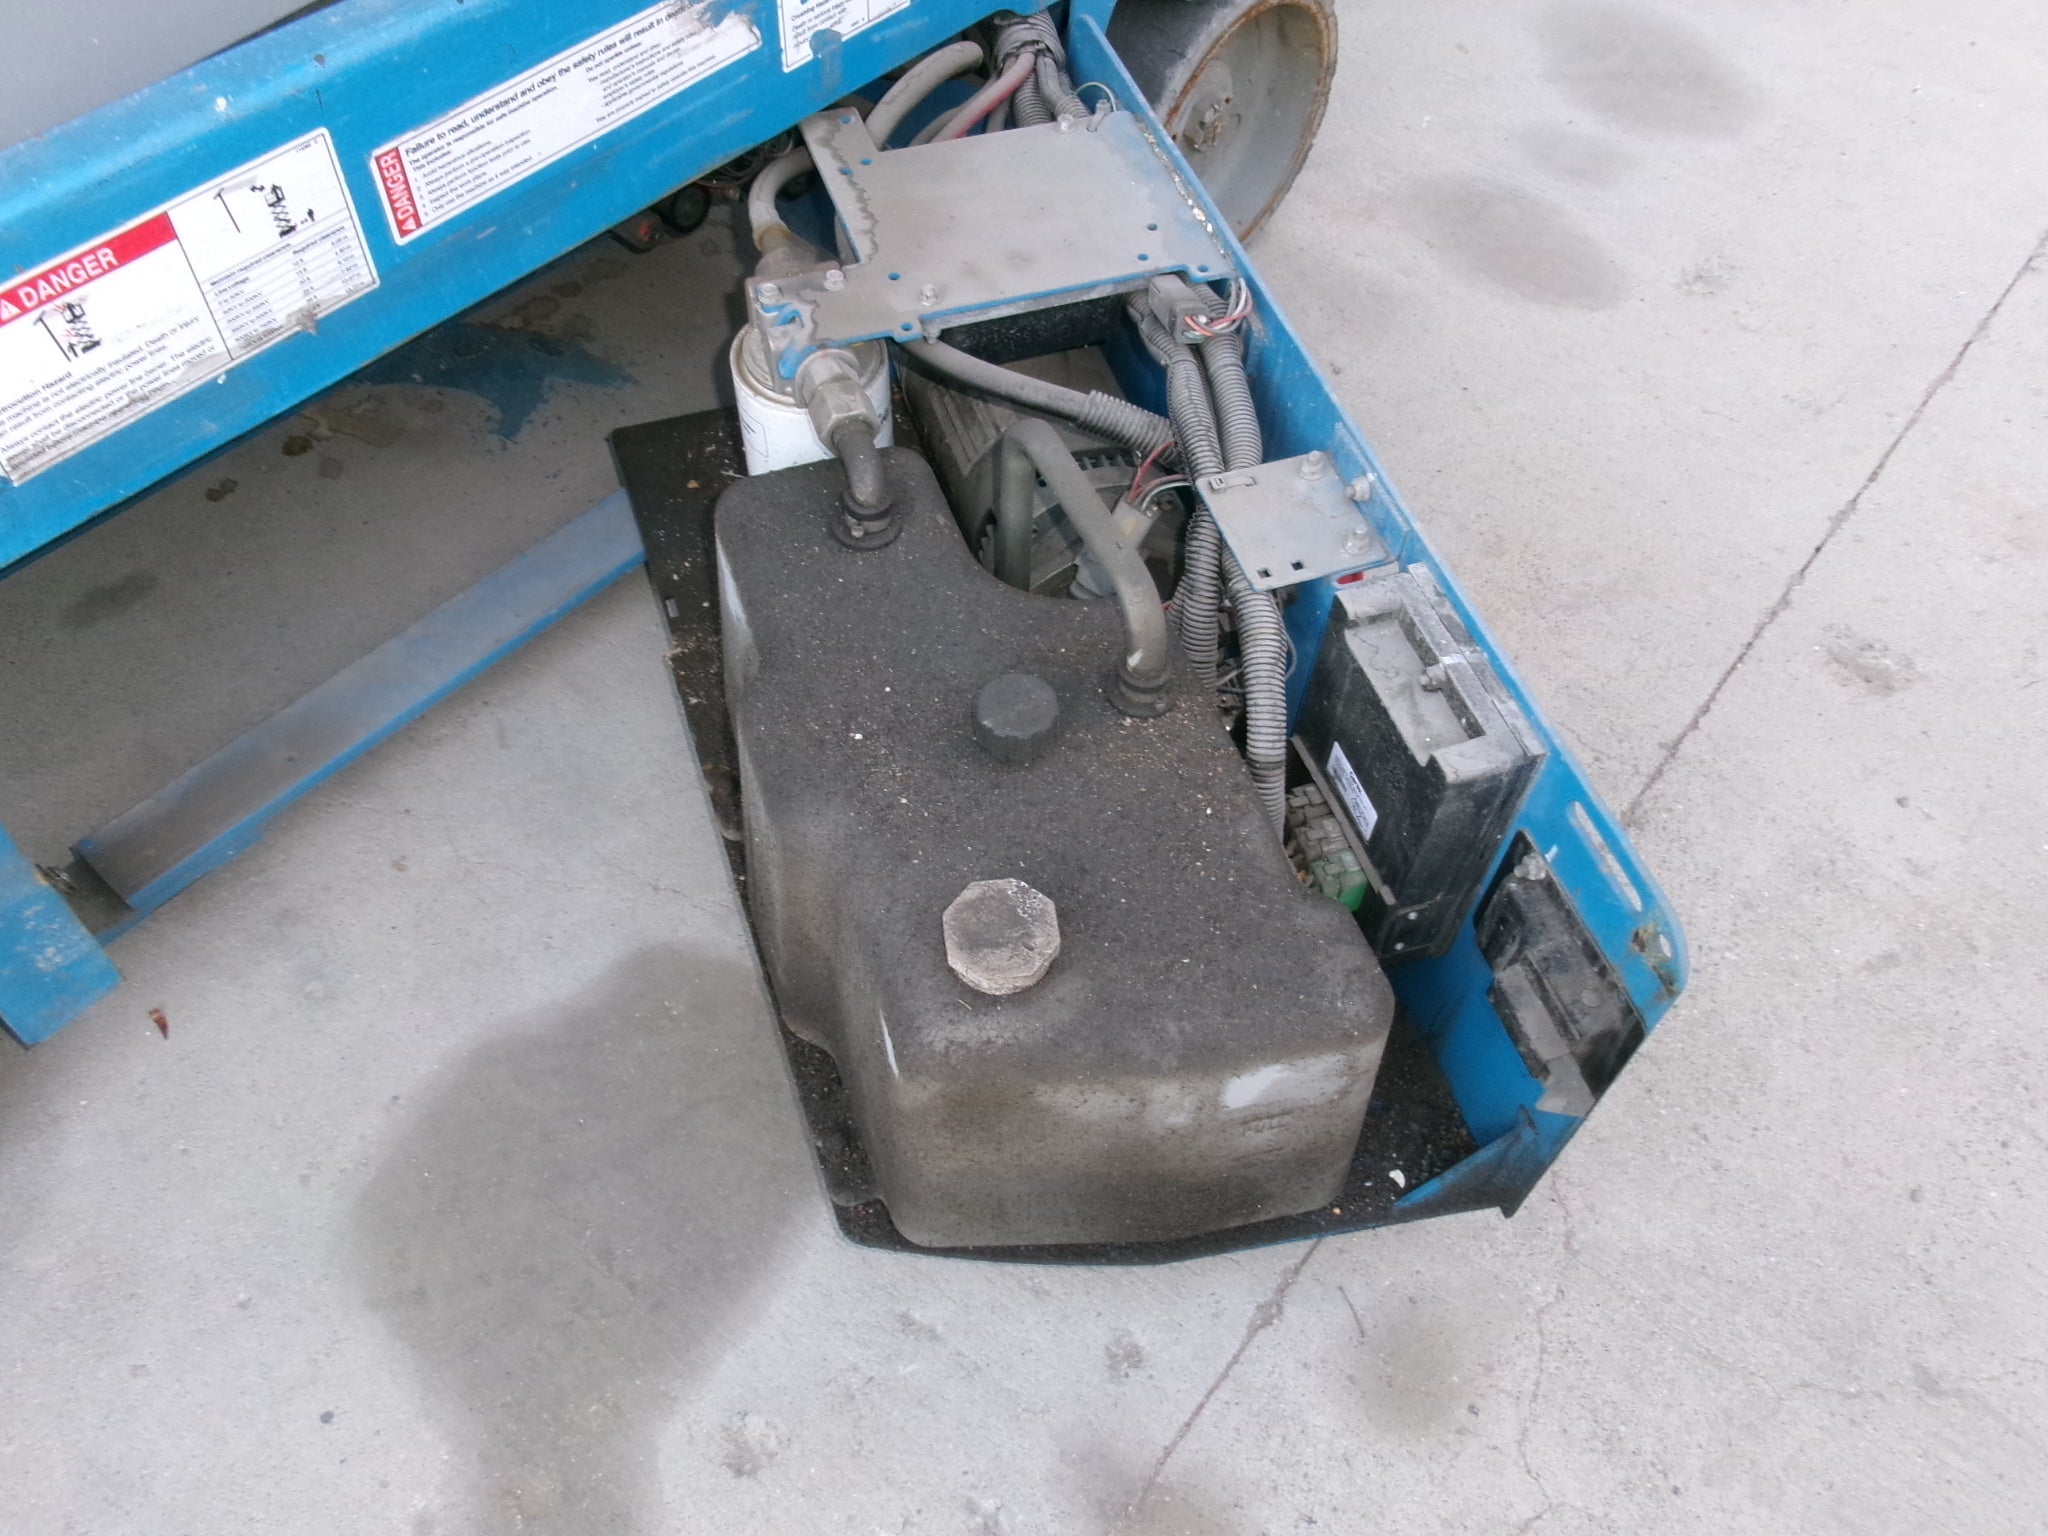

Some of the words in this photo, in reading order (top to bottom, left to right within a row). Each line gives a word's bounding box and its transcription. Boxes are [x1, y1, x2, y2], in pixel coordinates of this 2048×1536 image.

[404, 136, 435, 155] Failure
[436, 130, 446, 139] to
[447, 119, 468, 135] read,
[470, 93, 519, 121] understand
[518, 84, 535, 96] and
[535, 73, 557, 88] obey
[557, 65, 571, 76] the
[571, 52, 596, 70] safety
[597, 41, 617, 55] rules
[618, 33, 632, 44] will
[632, 21, 655, 37] result
[655, 17, 664, 25] in
[380, 151, 415, 220] DANGER
[17, 247, 118, 309] DANGER
[6, 401, 41, 420] machine
[49, 388, 64, 397] not
[64, 366, 106, 390] electrically
[144, 332, 169, 347] Death
[29, 419, 59, 437] contact
[59, 411, 73, 421] the
[73, 396, 102, 413] electric
[103, 384, 128, 399] power
[168, 350, 185, 361] The
[185, 336, 212, 352] electric
[32, 405, 53, 418] from
[94, 369, 122, 385] electric
[123, 356, 148, 371] power
[41, 371, 72, 391] Hazard
